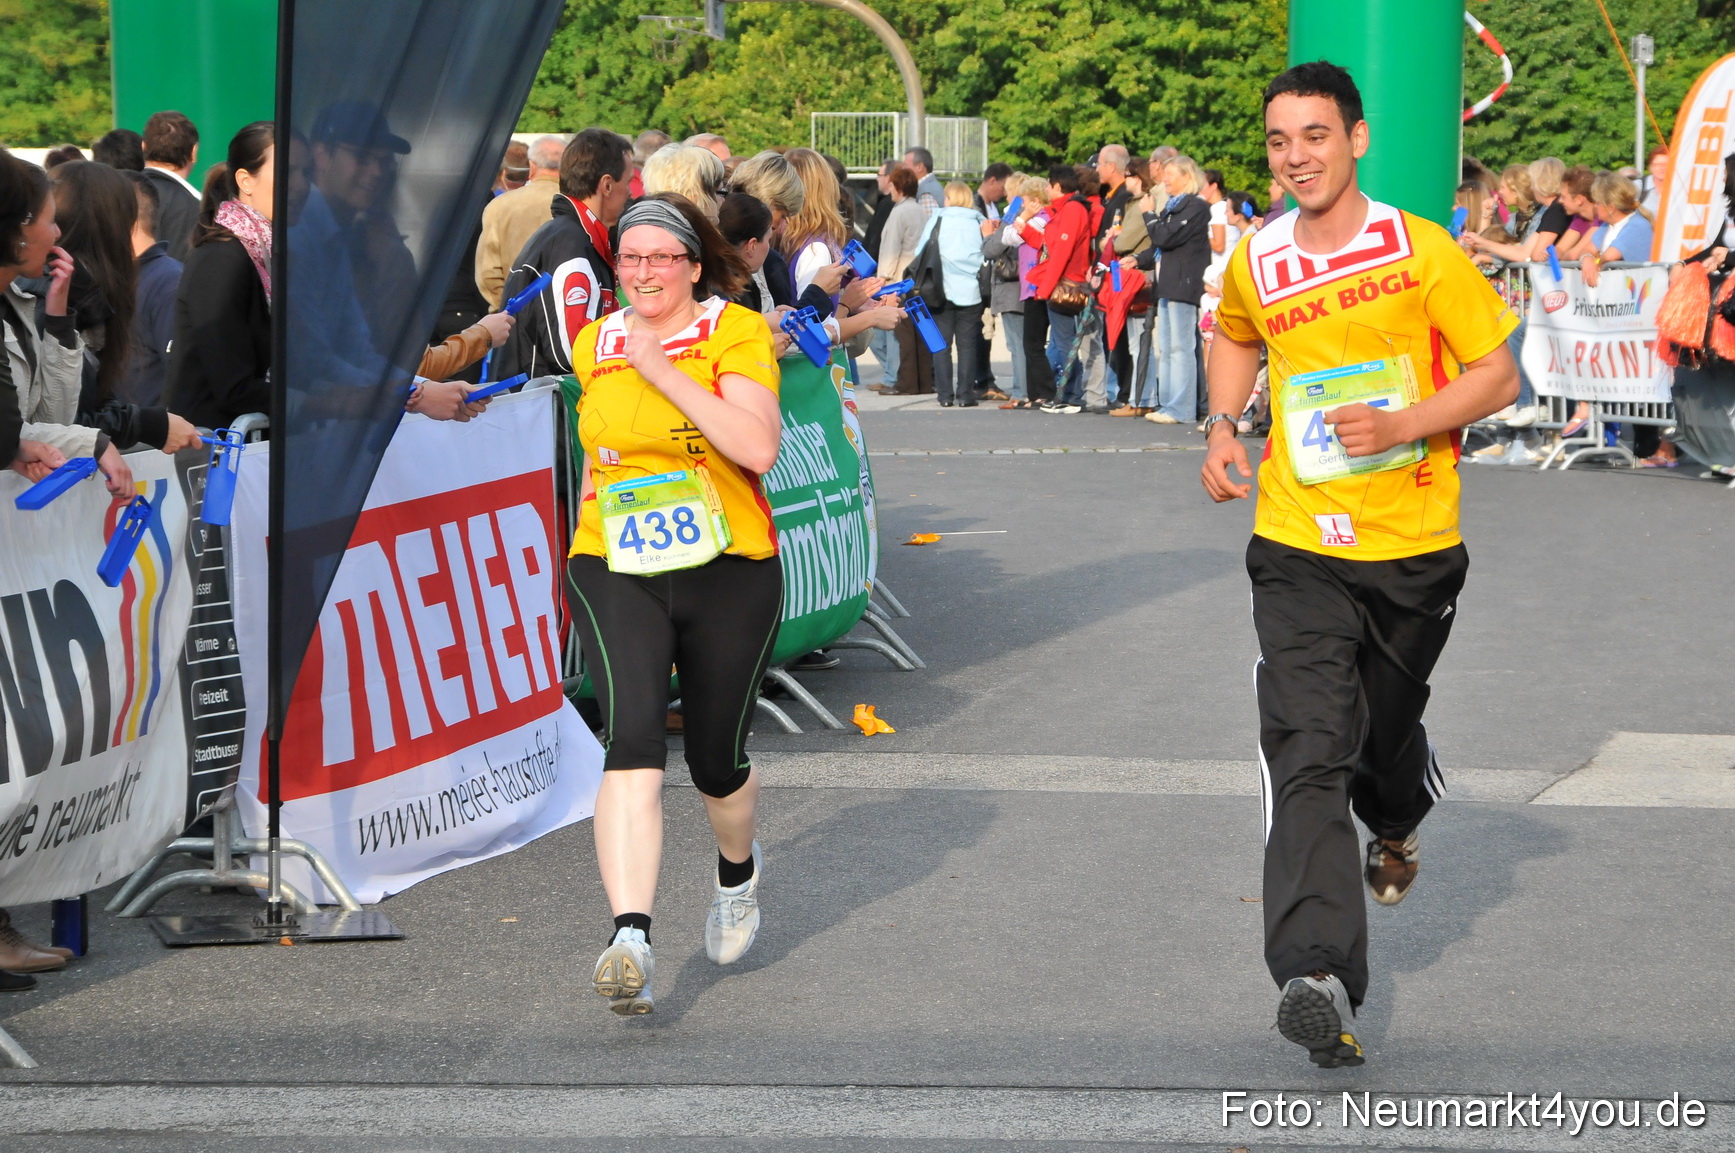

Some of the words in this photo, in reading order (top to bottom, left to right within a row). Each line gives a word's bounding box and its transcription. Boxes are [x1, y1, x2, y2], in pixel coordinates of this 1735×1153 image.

[1266, 297, 1330, 337] MAX
[1337, 270, 1420, 310] BÖGL
[1573, 298, 1636, 317] Frischmann
[1299, 389, 1342, 405] firmenlauf
[613, 497, 651, 511] firmenlauf
[619, 506, 700, 554] 438
[640, 554, 661, 565] Elke
[313, 502, 563, 767] MEIER
